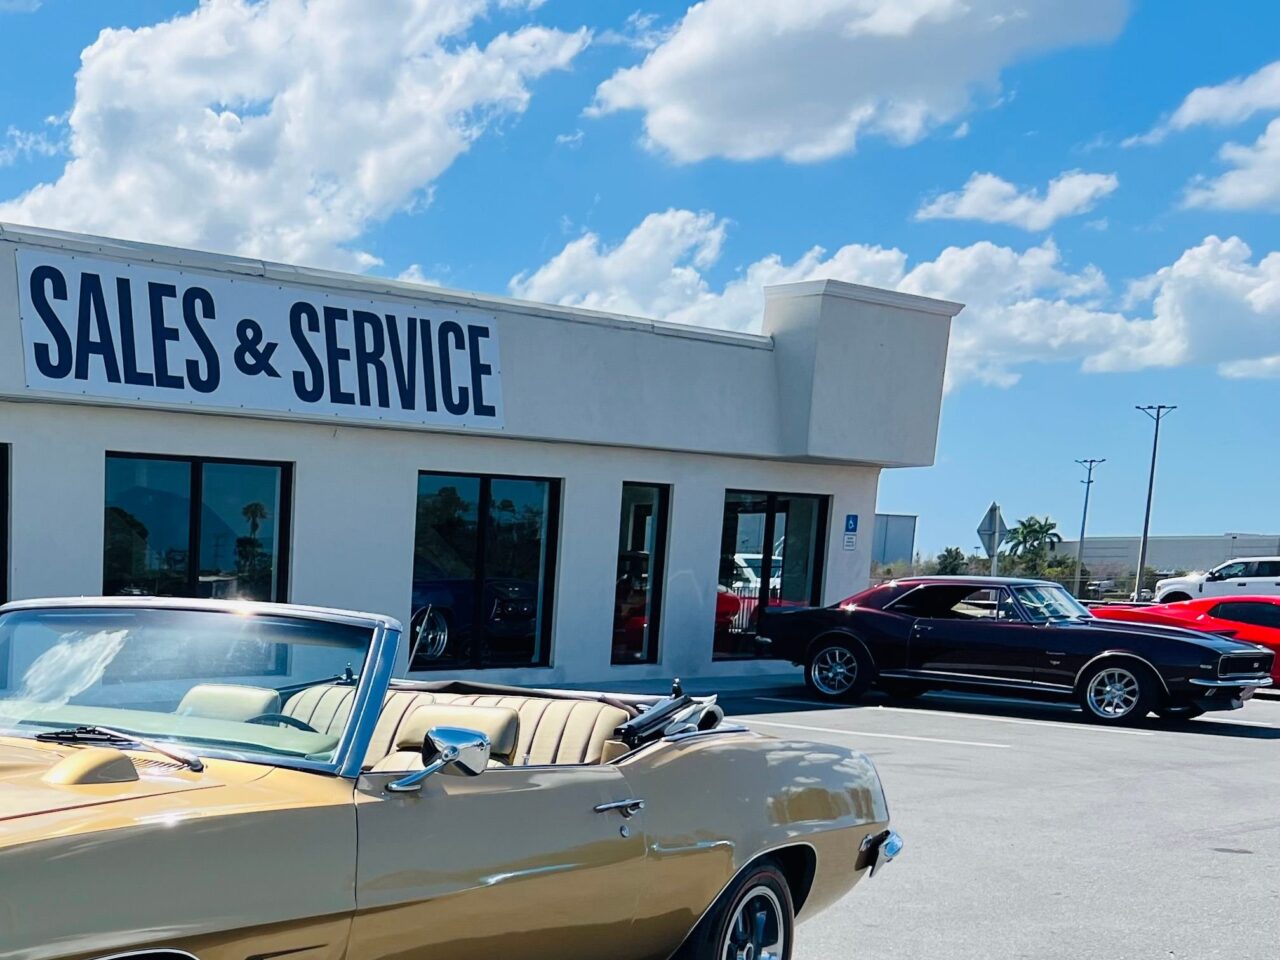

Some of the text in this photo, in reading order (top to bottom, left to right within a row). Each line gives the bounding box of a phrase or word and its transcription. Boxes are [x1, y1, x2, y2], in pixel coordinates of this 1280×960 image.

[29, 265, 496, 417] SALES & SERVICE
